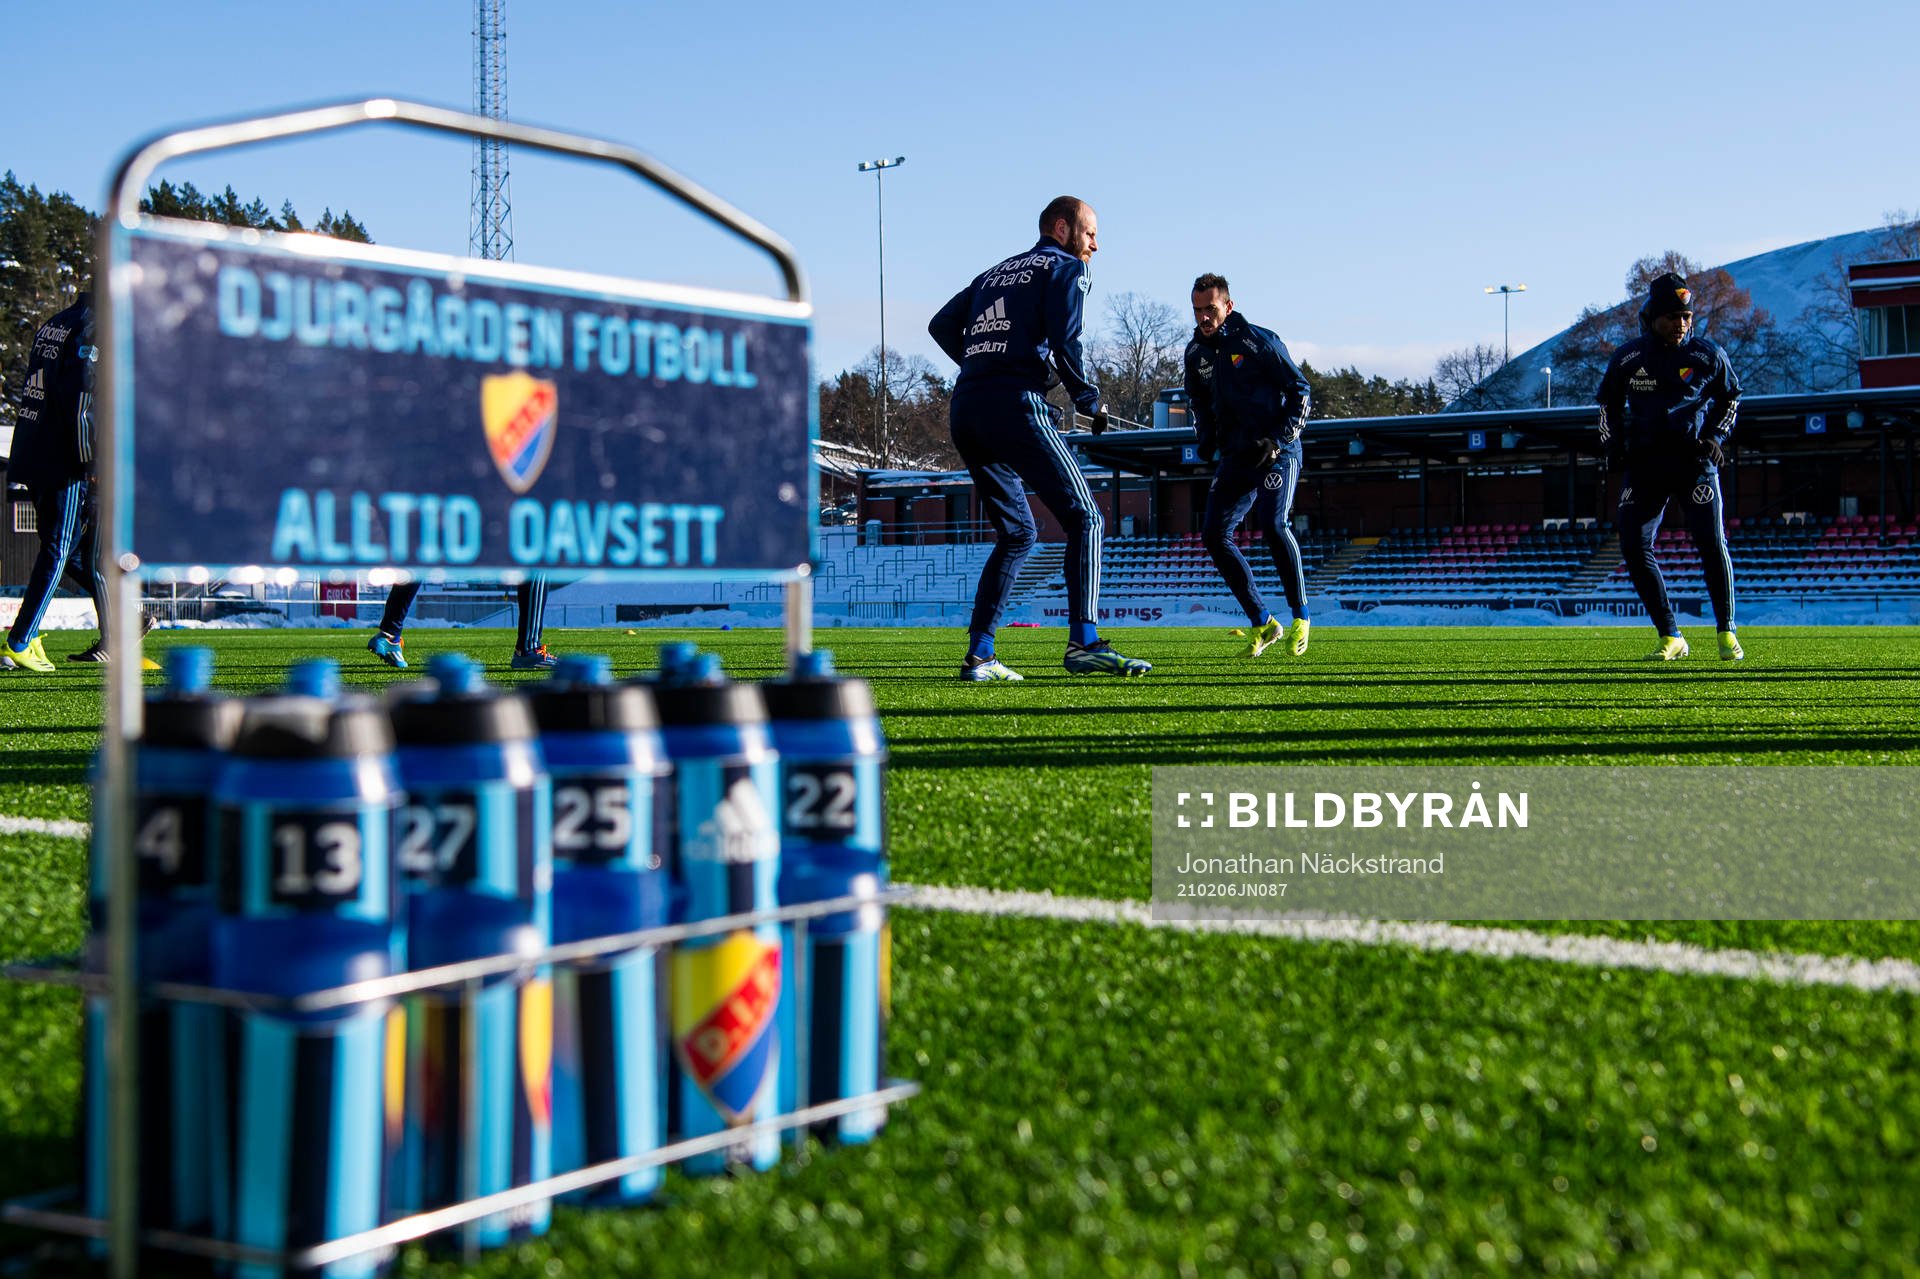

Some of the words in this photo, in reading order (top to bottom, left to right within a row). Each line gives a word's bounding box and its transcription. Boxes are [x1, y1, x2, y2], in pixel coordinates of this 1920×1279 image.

[981, 270, 1034, 290] Finans
[217, 264, 565, 370] DJURGÅRDEN
[572, 311, 758, 388] FOTBOLL
[971, 318, 1012, 336] adidas
[965, 341, 1008, 358] stadium
[1472, 433, 1482, 446] B
[1809, 416, 1821, 430] C
[1185, 448, 1194, 459] B
[271, 488, 482, 564] ALLTID
[509, 497, 725, 566] OAVSETT
[326, 588, 351, 601] GIRLS
[554, 786, 634, 849] 25
[787, 771, 856, 829] 22
[137, 806, 184, 873] 4
[400, 803, 478, 872] 27
[273, 823, 363, 894] 13
